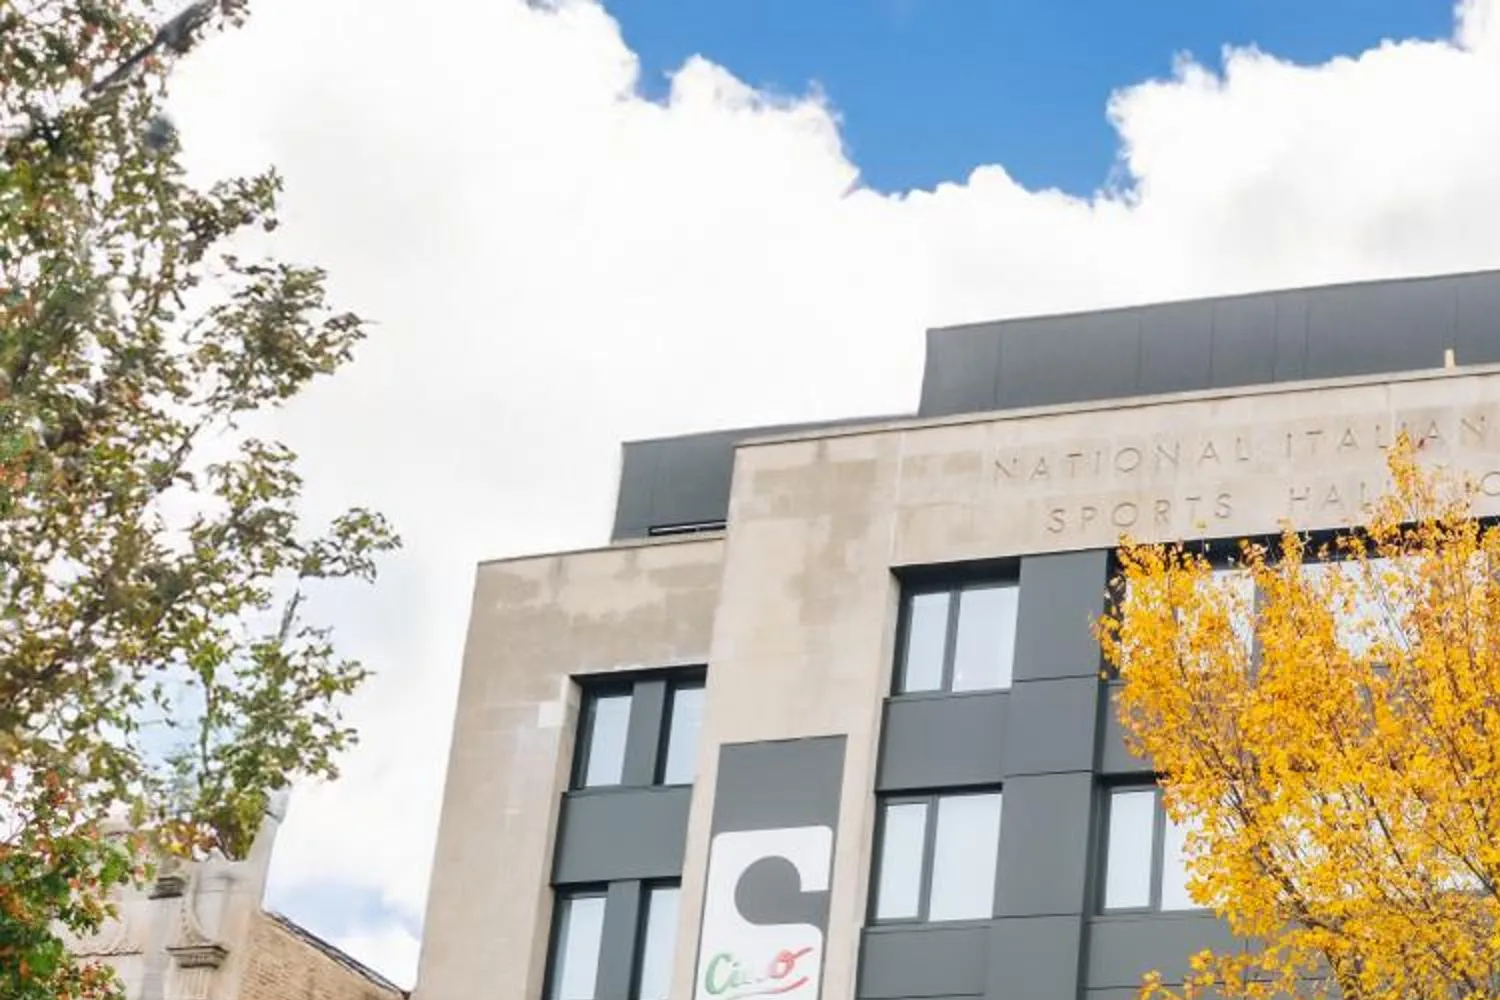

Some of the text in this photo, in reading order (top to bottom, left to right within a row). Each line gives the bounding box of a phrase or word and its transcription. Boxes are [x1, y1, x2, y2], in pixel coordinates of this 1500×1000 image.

[993, 437, 1249, 481] NATIONAL
[1285, 415, 1486, 458] ITALAN
[1046, 492, 1233, 534] SPORTS
